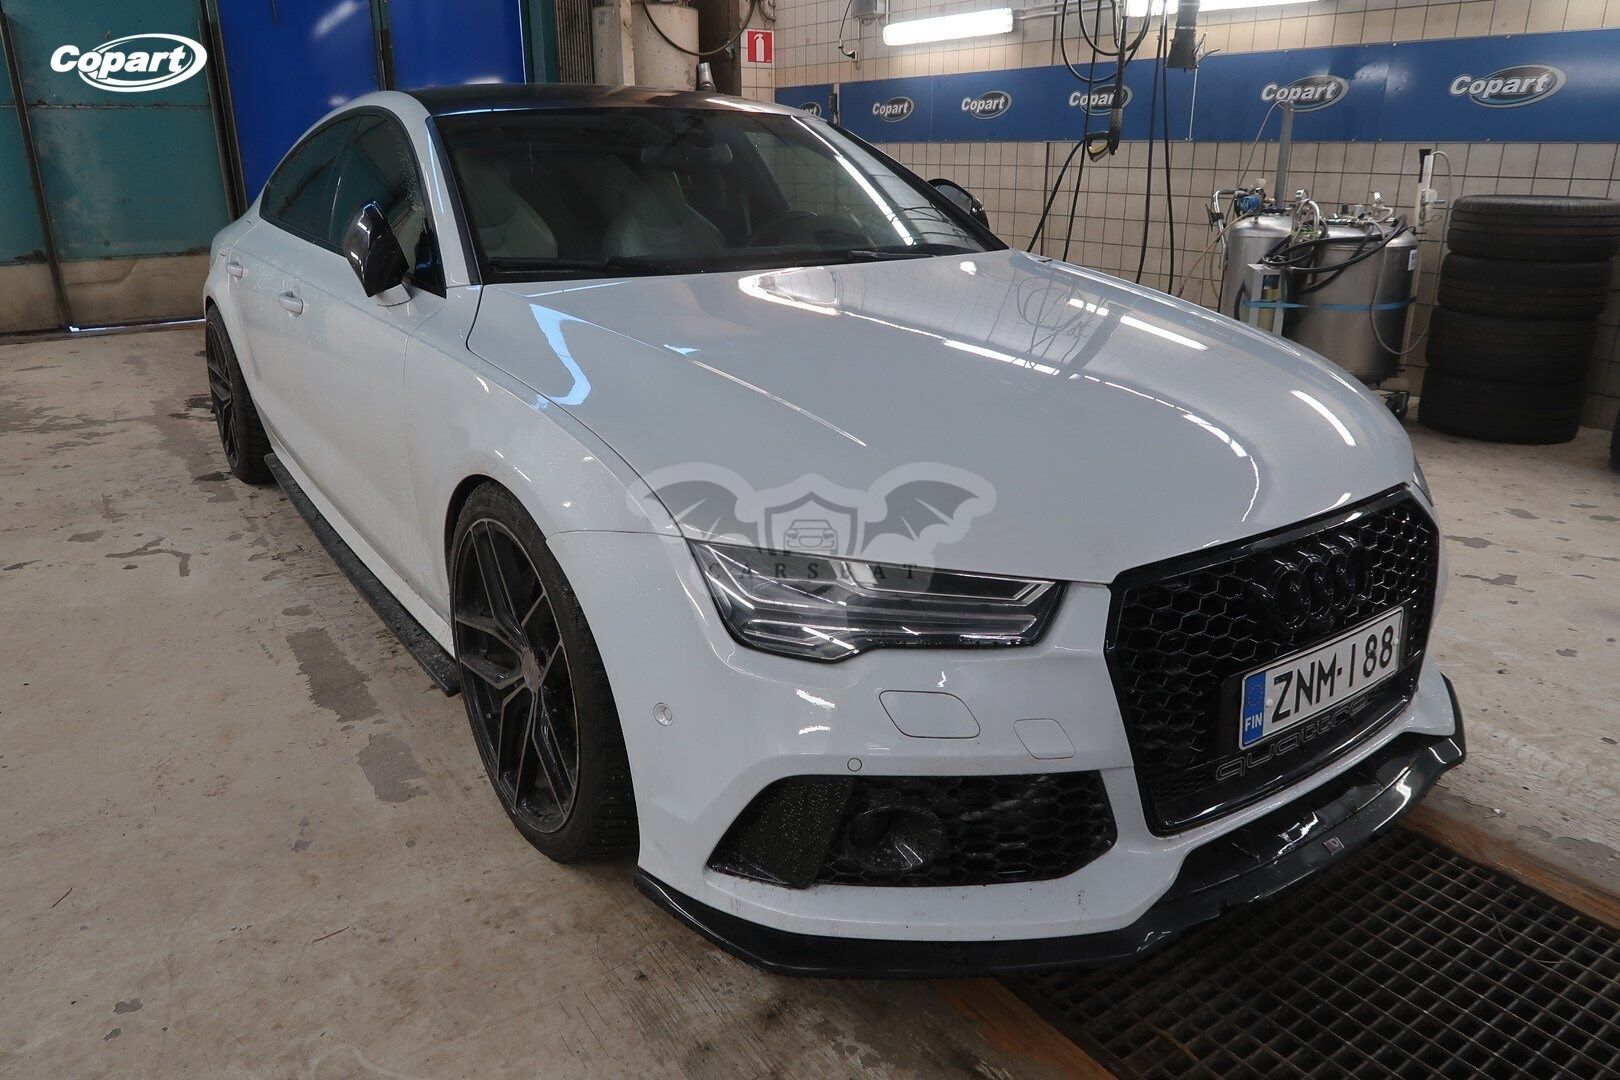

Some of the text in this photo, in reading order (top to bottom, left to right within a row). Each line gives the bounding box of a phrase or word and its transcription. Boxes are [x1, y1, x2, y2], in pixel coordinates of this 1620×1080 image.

[1261, 81, 1338, 102] Copart
[1450, 72, 1551, 99] Copart
[872, 101, 909, 117] Copart
[961, 96, 1005, 112] Copart
[1271, 625, 1394, 724] ZNM-188
[1244, 712, 1263, 732] FIN
[1216, 692, 1373, 781] quattro
